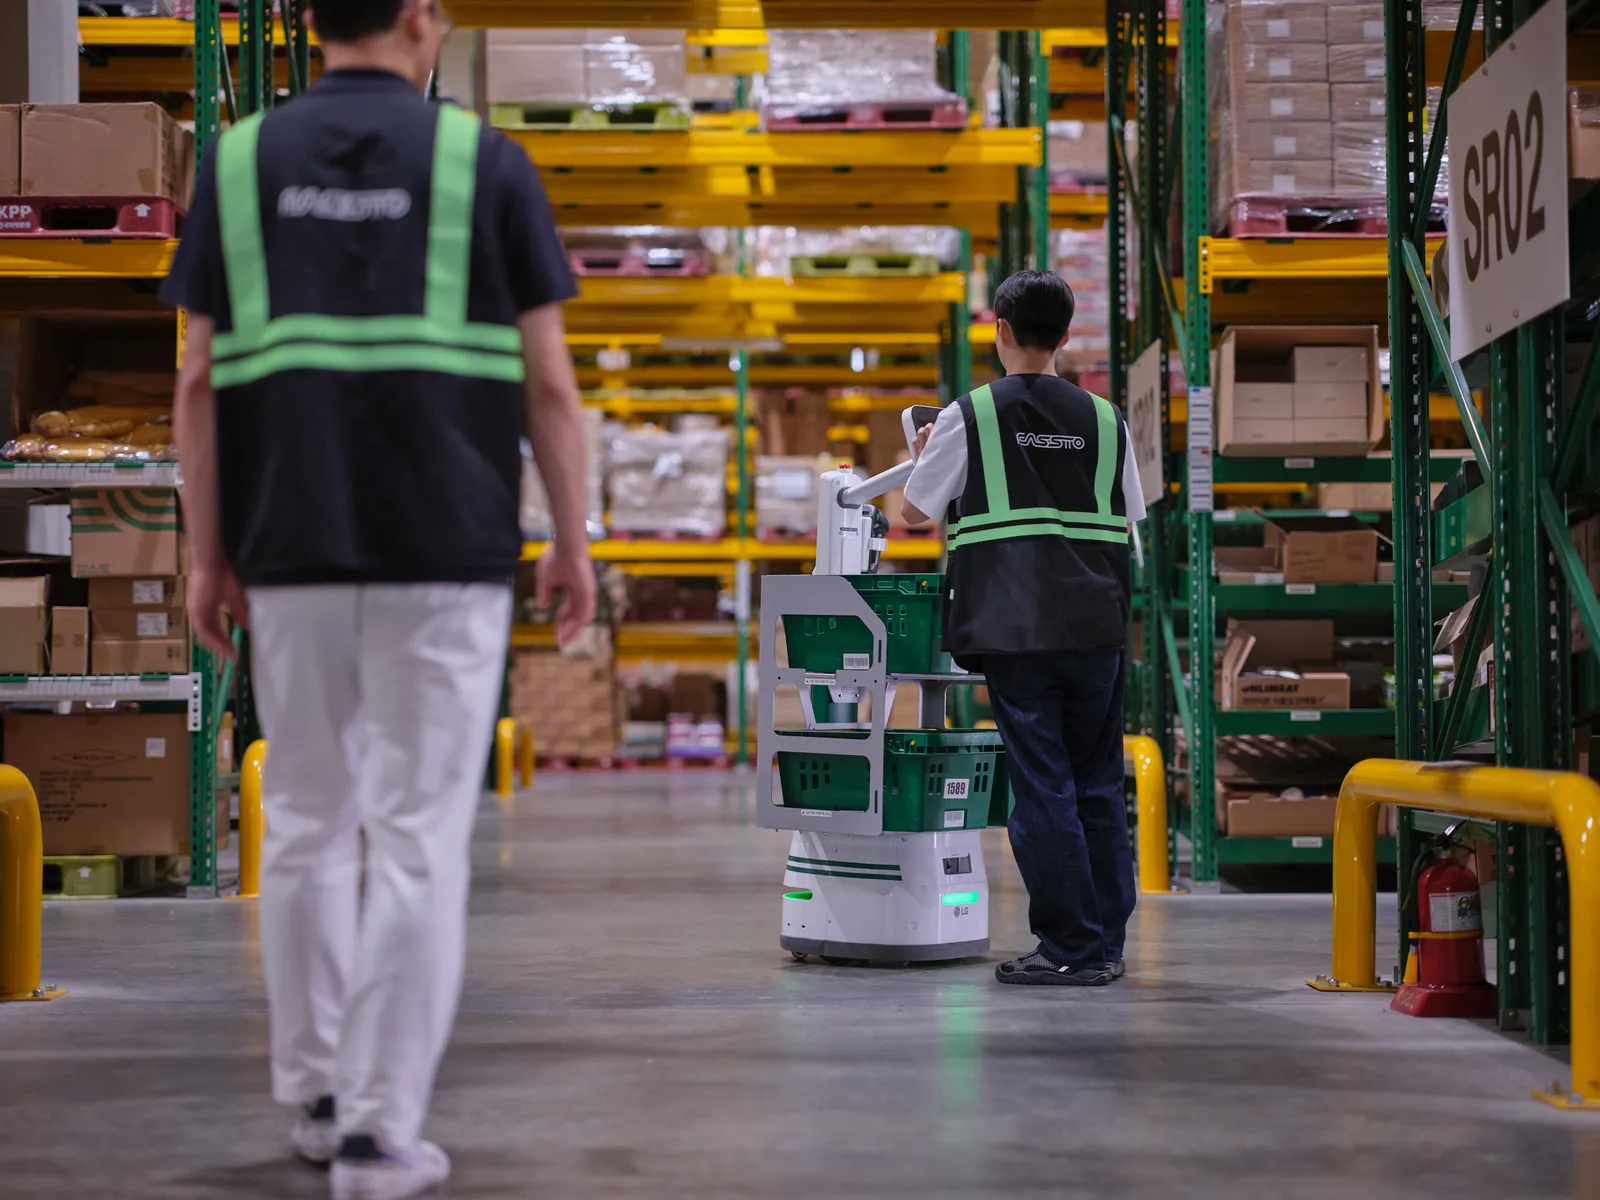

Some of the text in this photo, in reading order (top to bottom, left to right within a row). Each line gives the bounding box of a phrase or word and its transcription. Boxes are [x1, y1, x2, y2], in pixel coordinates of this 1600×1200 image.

[1464, 90, 1545, 282] SR02
[0, 205, 31, 219] KPP
[1016, 432, 1085, 450] FASSTO
[947, 782, 966, 795] 1589
[961, 906, 969, 915] LG
